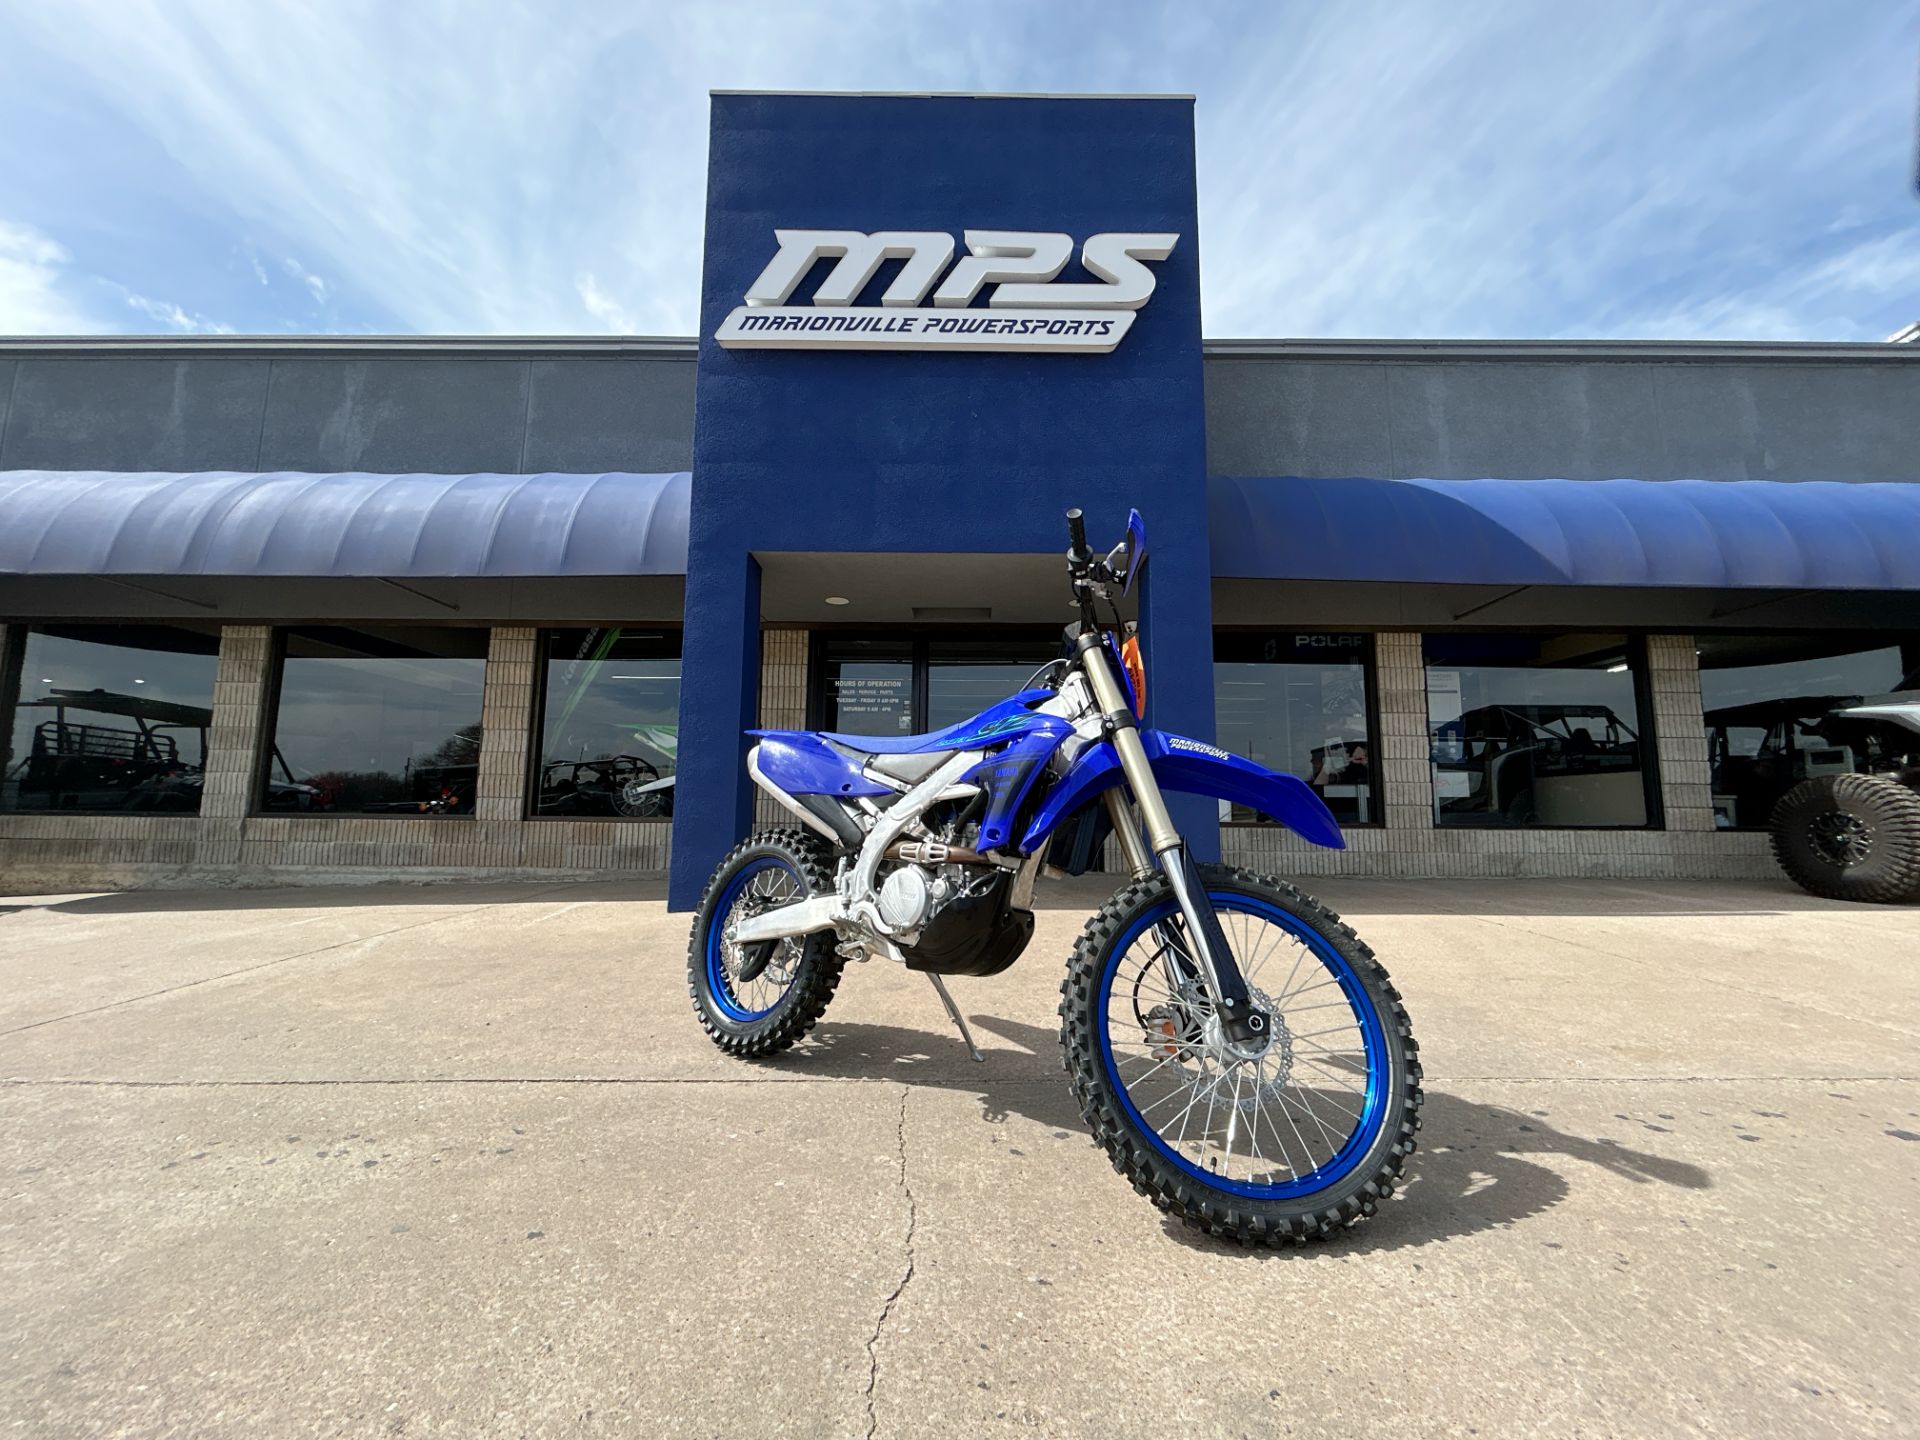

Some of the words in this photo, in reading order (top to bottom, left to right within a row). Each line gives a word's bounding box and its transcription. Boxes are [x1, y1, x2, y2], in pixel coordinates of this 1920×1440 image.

[745, 229, 1180, 309] MPS
[738, 315, 918, 333] MARIONVILLE
[922, 318, 1114, 336] POWERSPORTS
